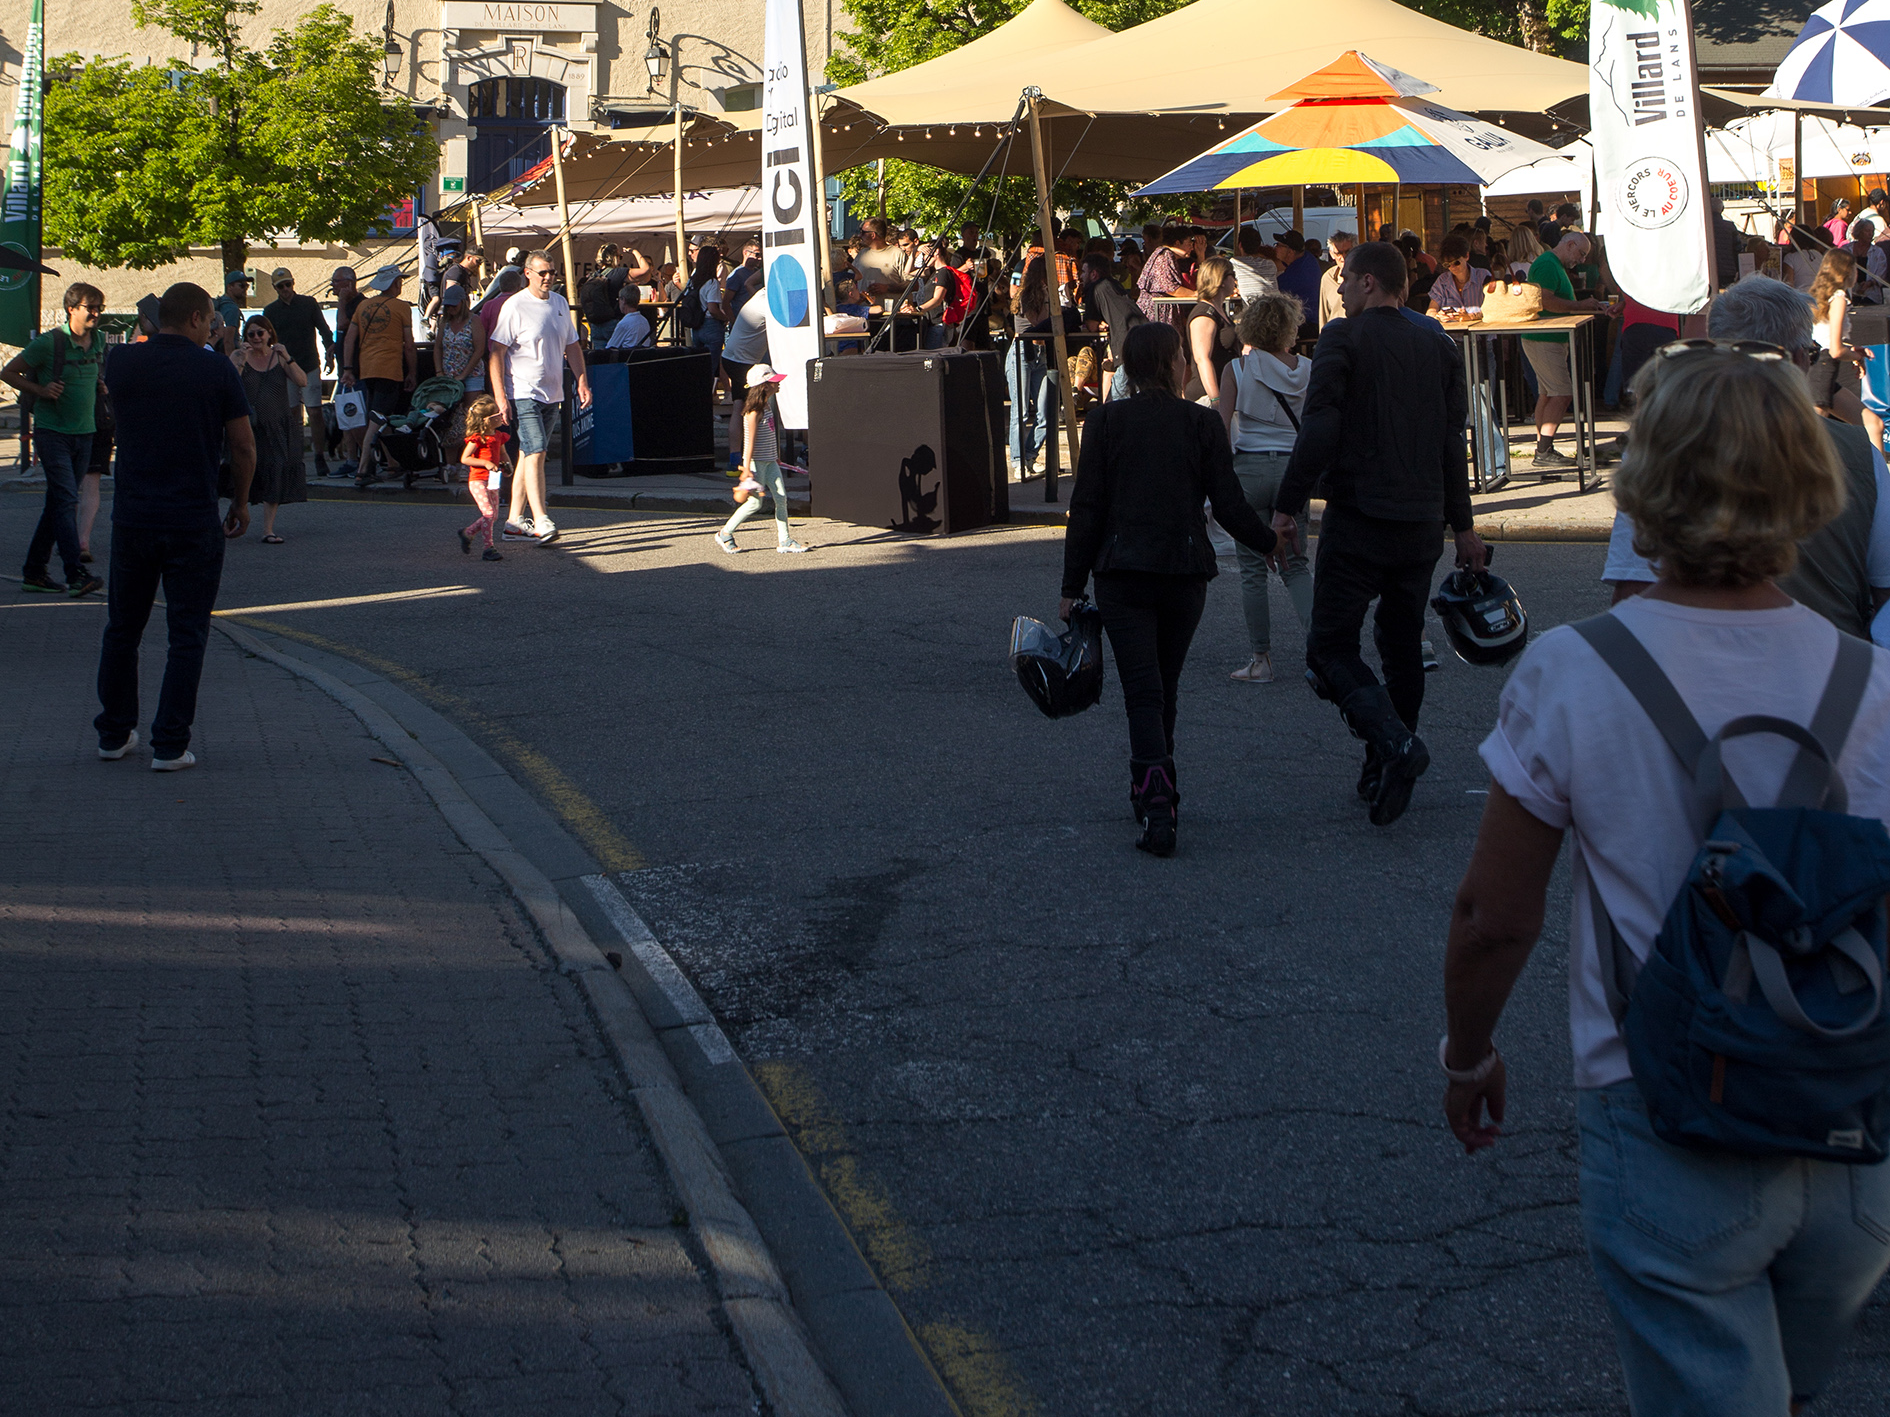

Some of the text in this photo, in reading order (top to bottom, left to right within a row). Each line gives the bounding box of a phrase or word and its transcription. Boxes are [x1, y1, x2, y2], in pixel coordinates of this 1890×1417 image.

[483, 3, 560, 22] MAISON
[1668, 28, 1682, 81] LANS
[568, 73, 585, 81] 1889
[1626, 31, 1667, 126] Villard
[1675, 95, 1686, 118] DE
[5, 161, 31, 223] Villard
[33, 161, 42, 197] LANS
[765, 146, 805, 248] ici
[1627, 168, 1656, 218] LE VERCORS
[1657, 168, 1678, 216] AU COEUR
[31, 206, 40, 221] DE
[105, 330, 127, 344] lard
